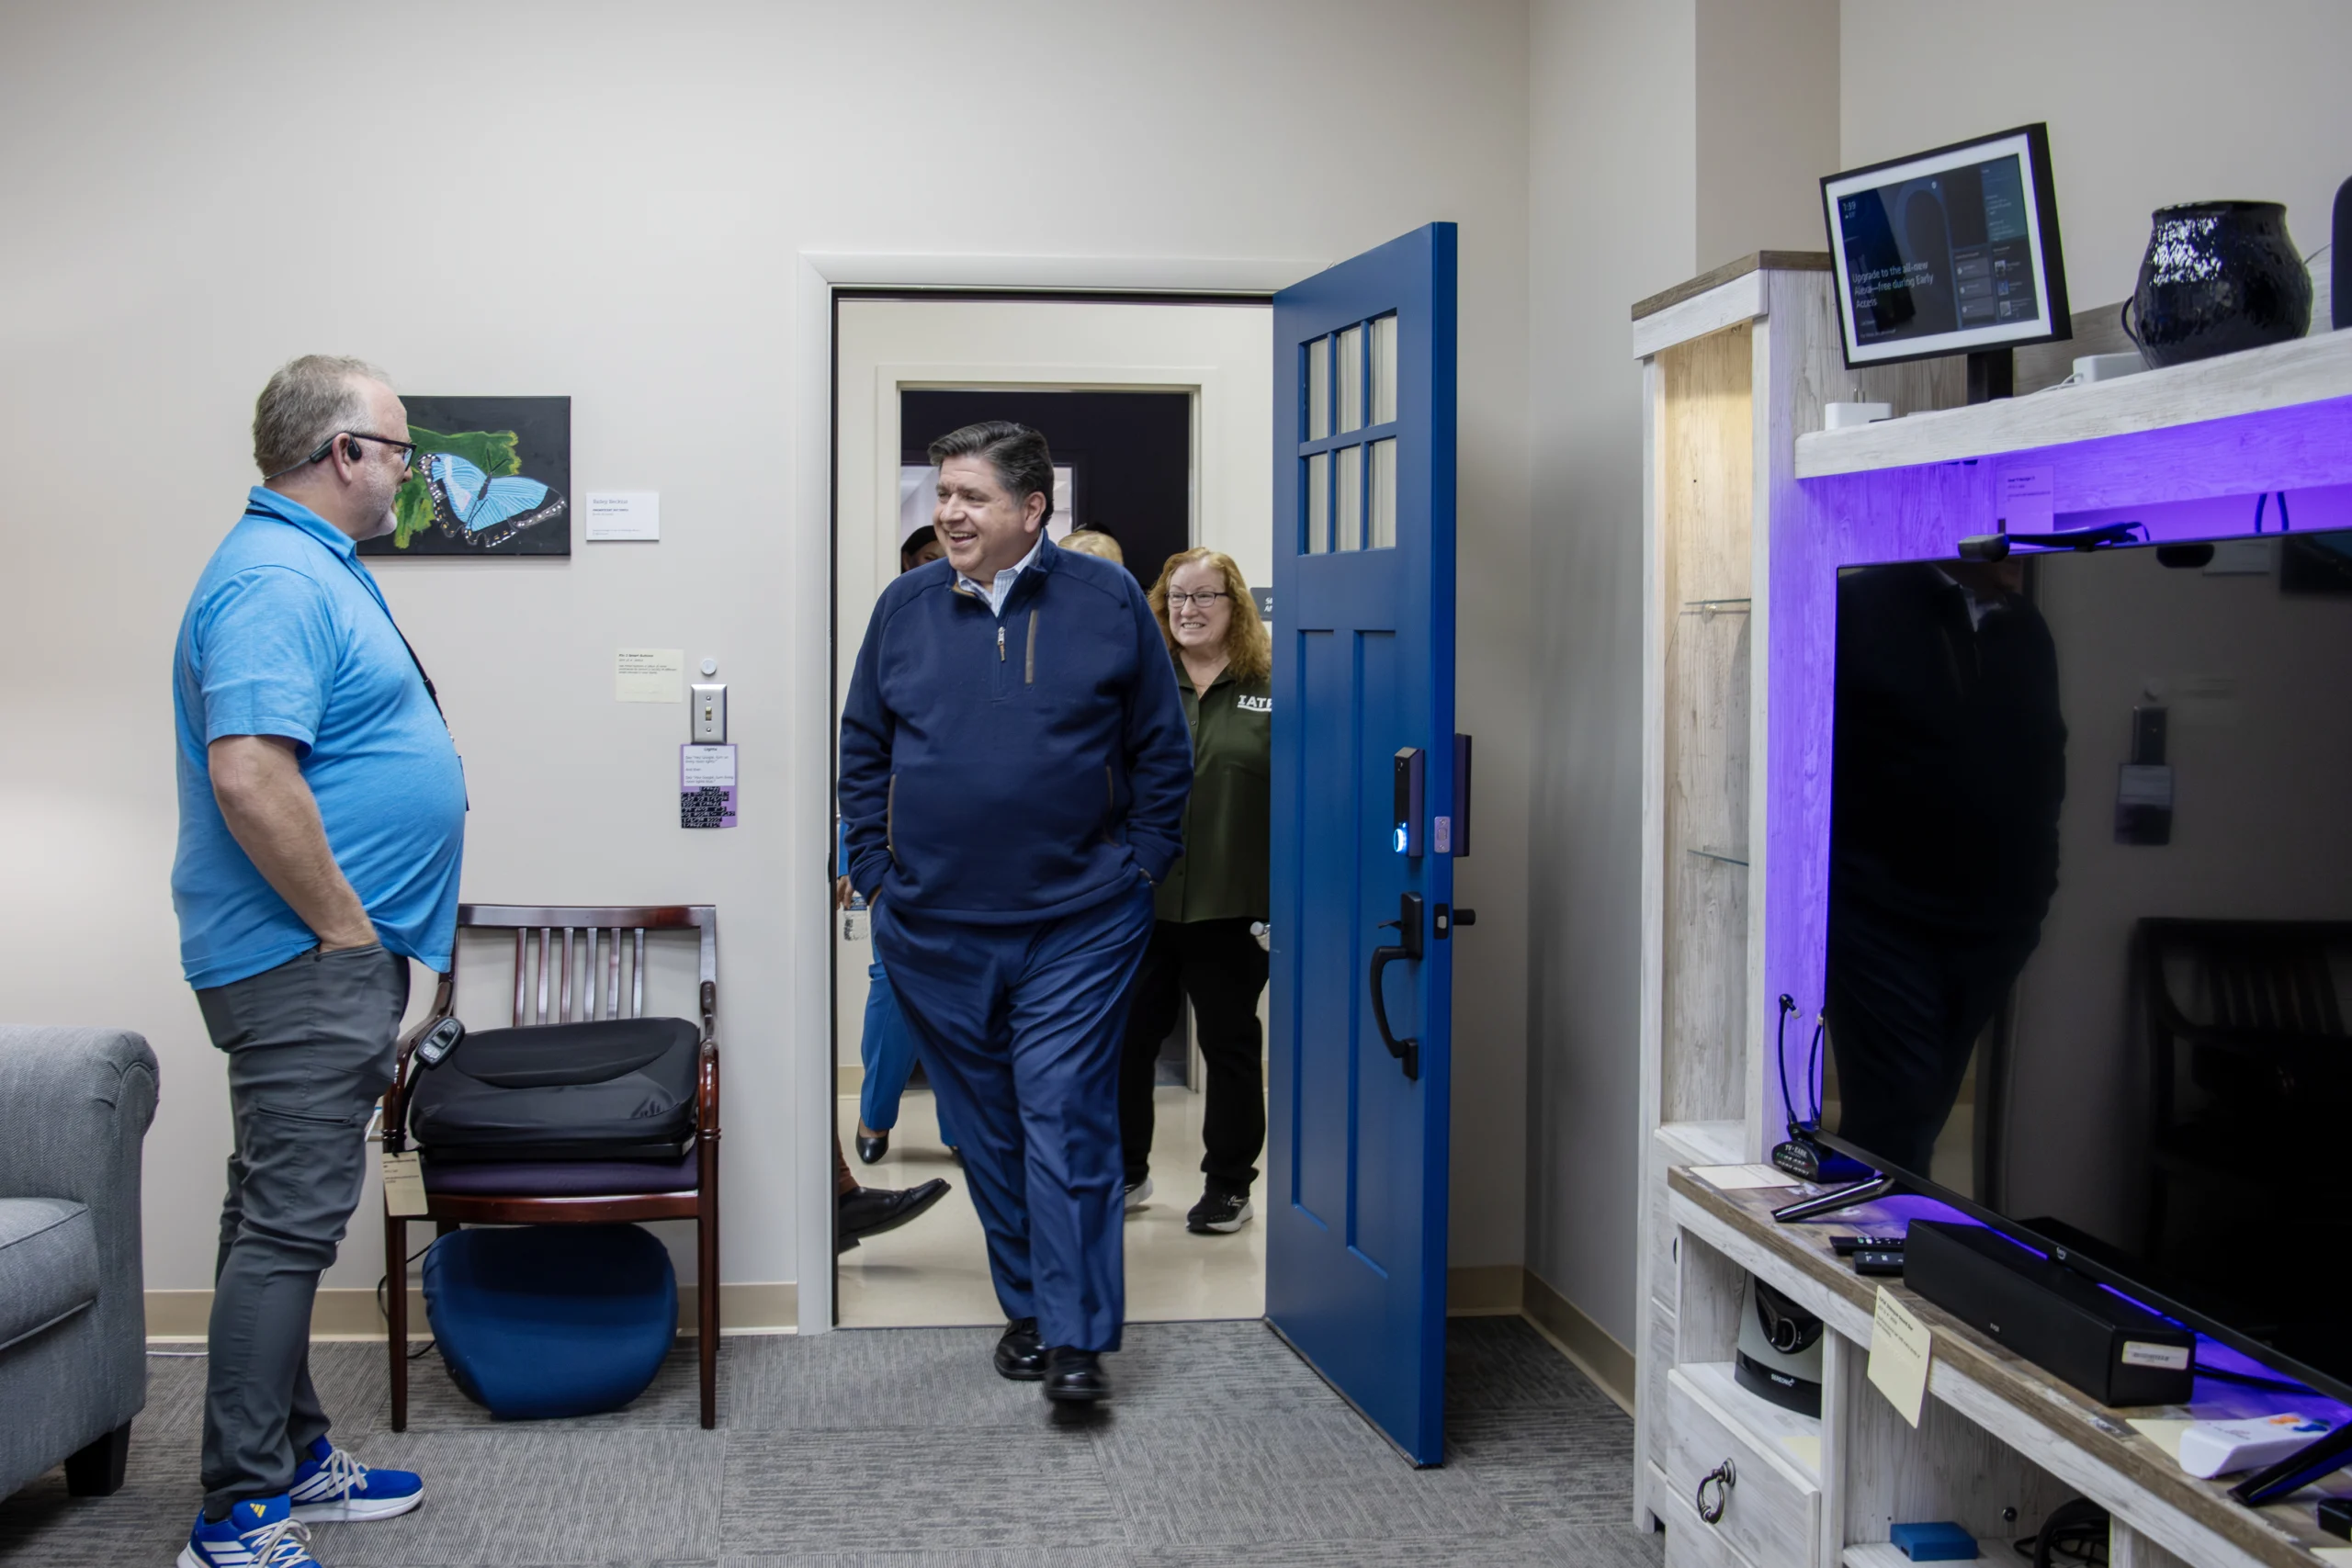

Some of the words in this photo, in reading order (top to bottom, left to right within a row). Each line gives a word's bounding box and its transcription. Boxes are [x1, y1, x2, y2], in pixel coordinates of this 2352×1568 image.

[1852, 269, 1881, 284] Upgrade
[1881, 268, 1889, 277] to
[1890, 265, 1902, 276] the
[1903, 261, 1928, 274] all-new
[1893, 277, 1916, 288] during
[1916, 273, 1934, 287] Early
[1856, 298, 1878, 309] Access
